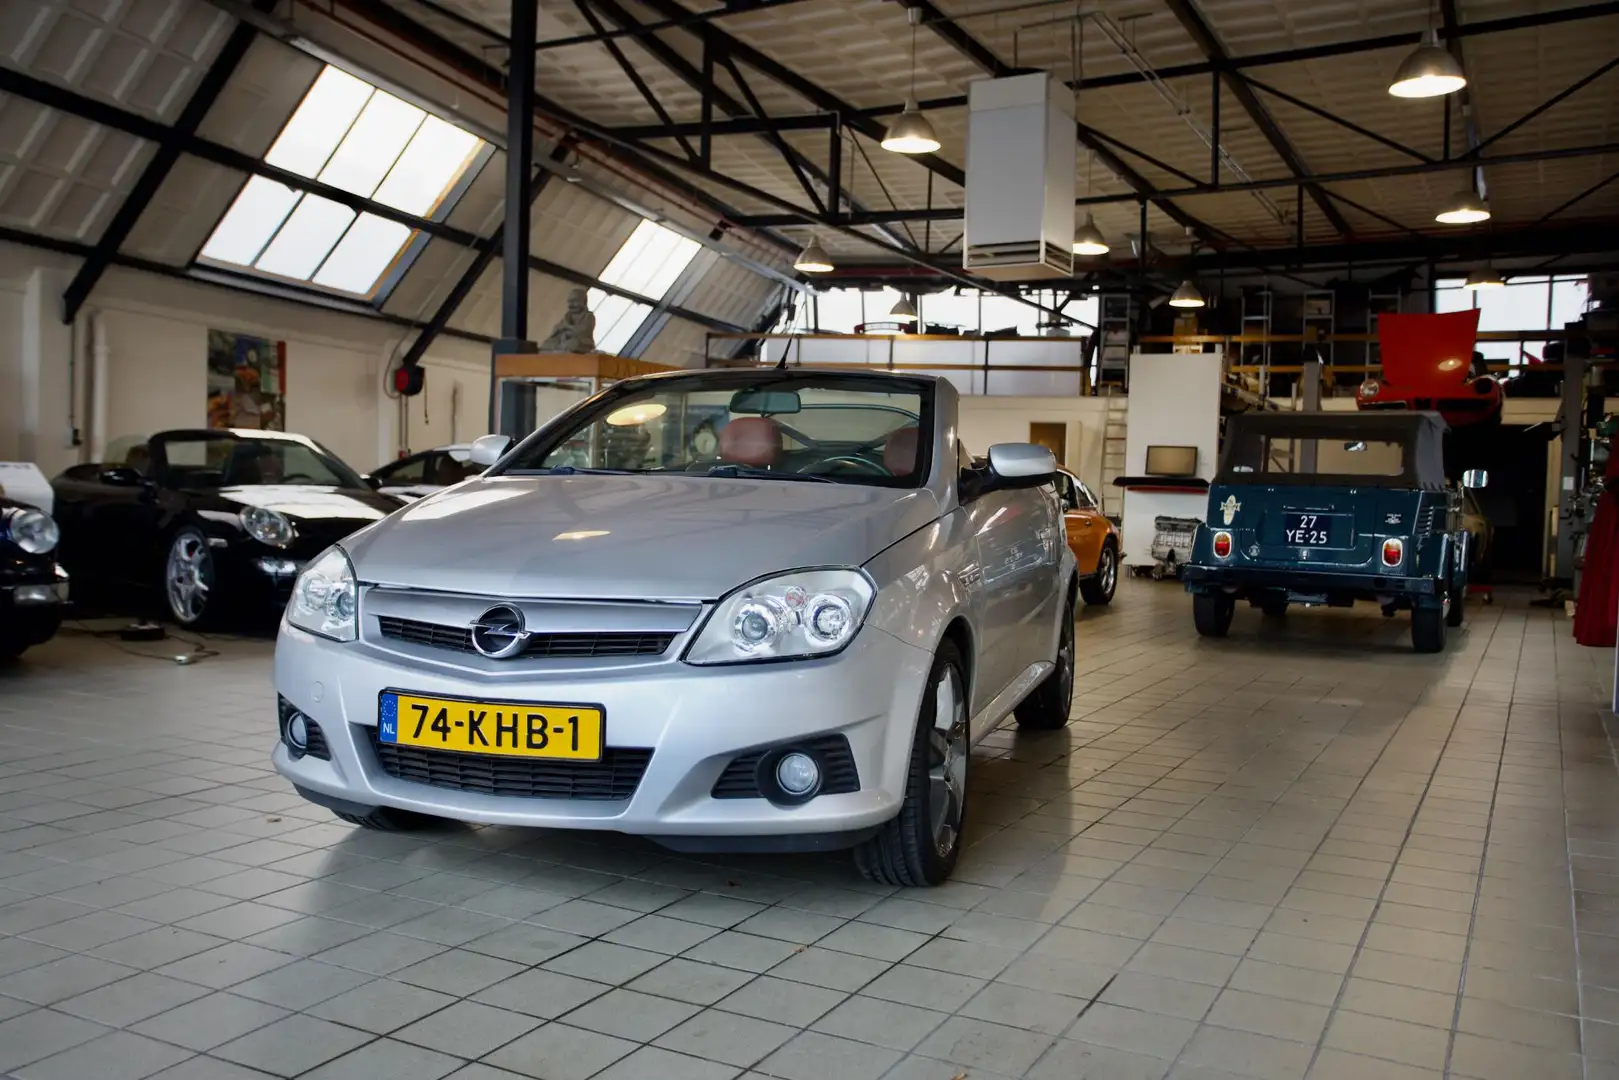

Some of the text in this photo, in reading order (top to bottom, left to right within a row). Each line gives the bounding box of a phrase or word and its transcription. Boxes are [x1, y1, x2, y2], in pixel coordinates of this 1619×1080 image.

[1300, 515, 1317, 528] 27
[382, 722, 395, 735] NL
[411, 704, 579, 751] 74-KHB-1
